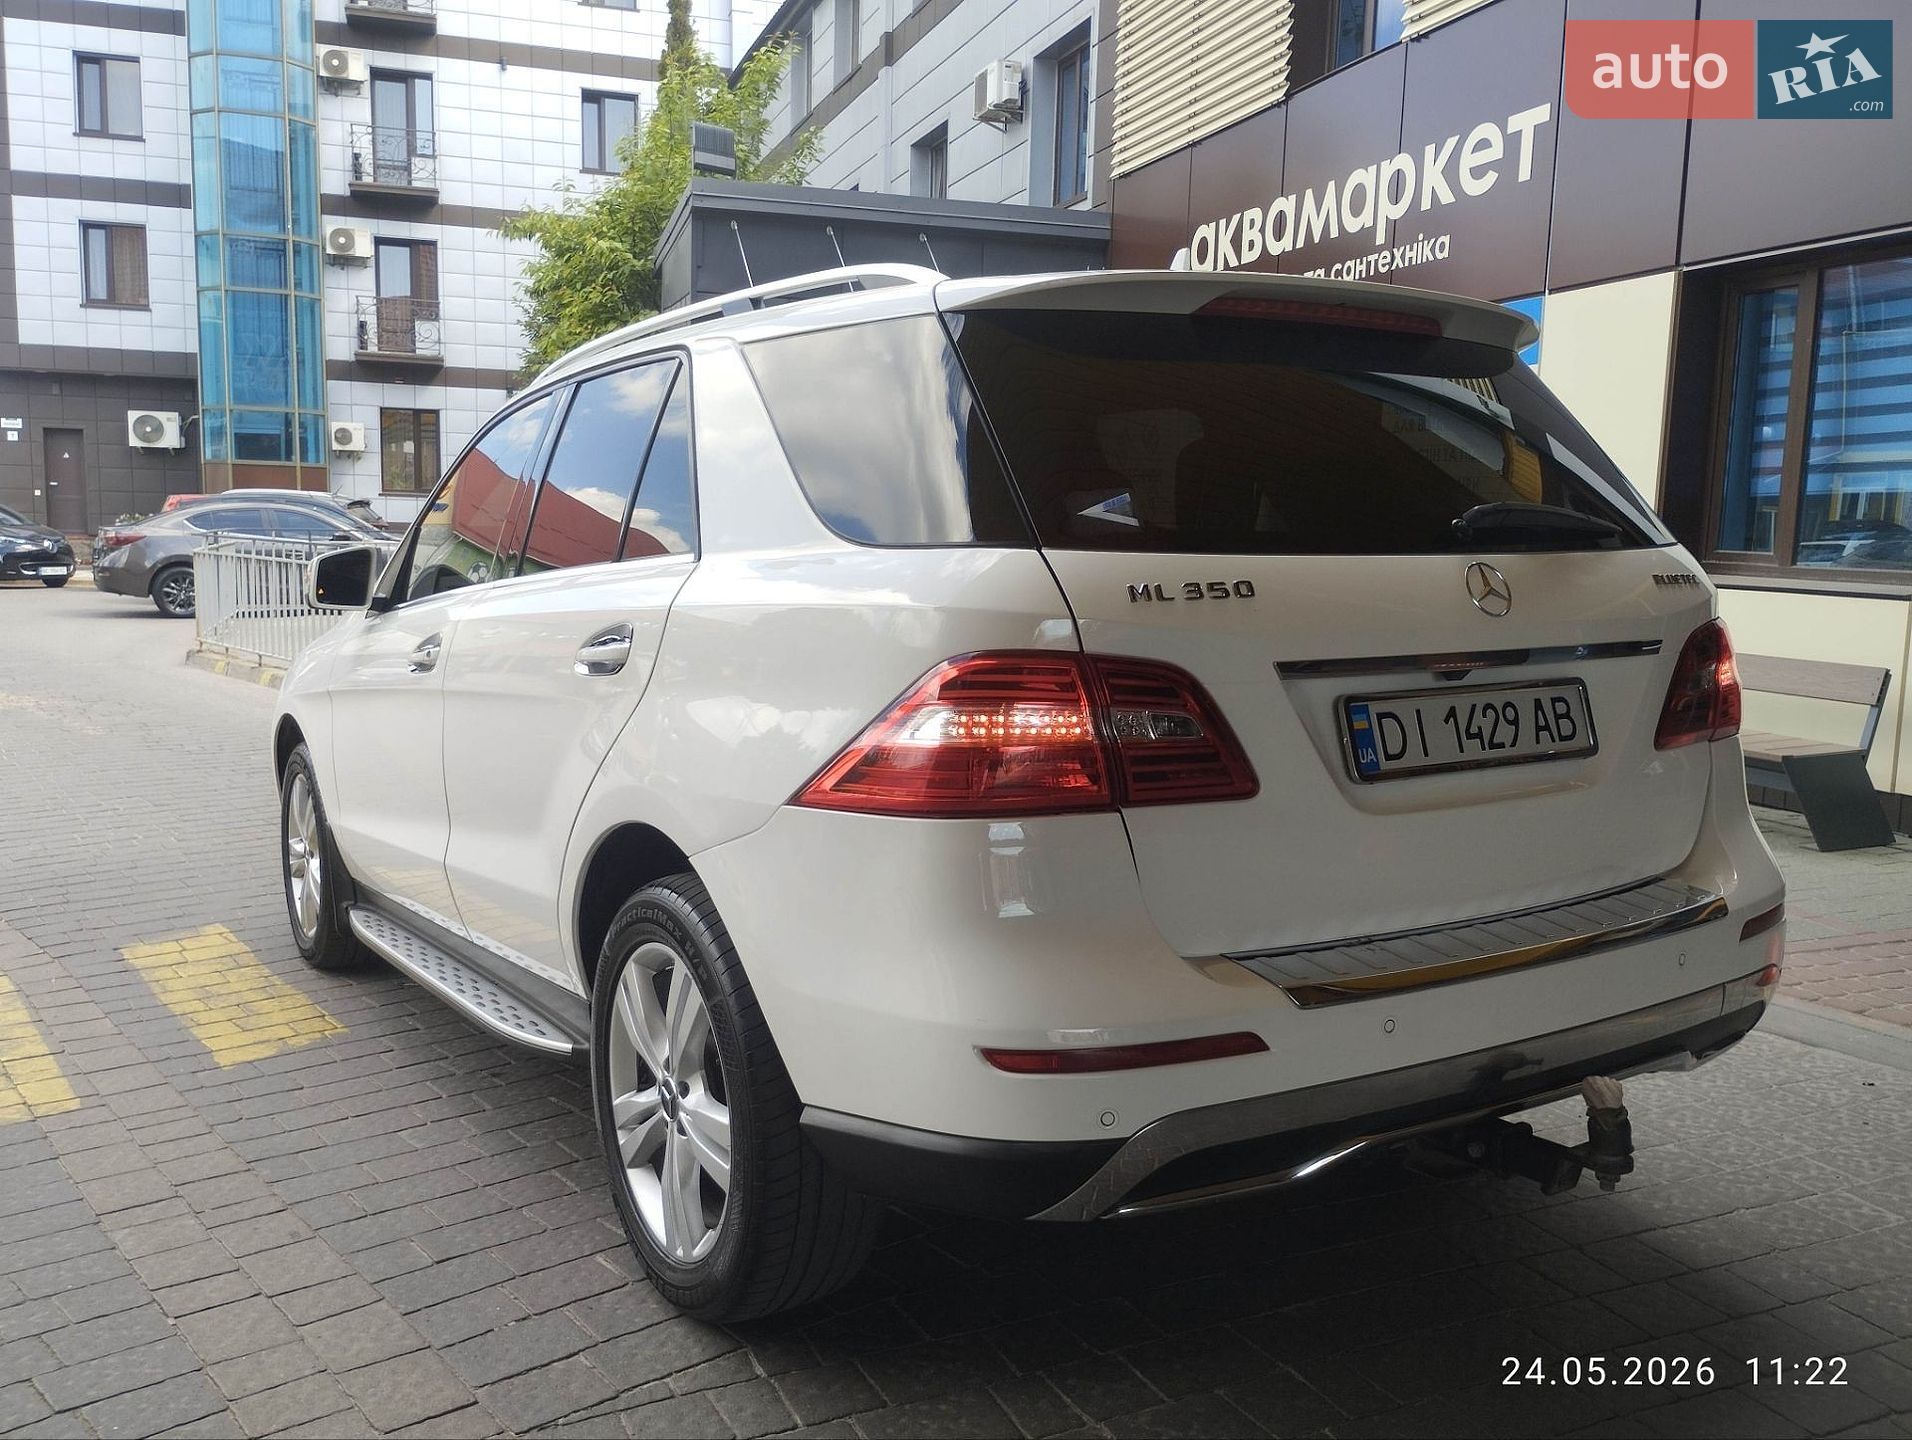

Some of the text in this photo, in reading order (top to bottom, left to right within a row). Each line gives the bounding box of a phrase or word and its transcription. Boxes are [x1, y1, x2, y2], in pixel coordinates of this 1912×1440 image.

[1191, 103, 1551, 272] аквамаркет
[1331, 233, 1451, 281] сантехніка
[1126, 580, 1255, 602] ML 350
[1375, 696, 1577, 762] DI 1429 AB
[1359, 748, 1378, 763] UA
